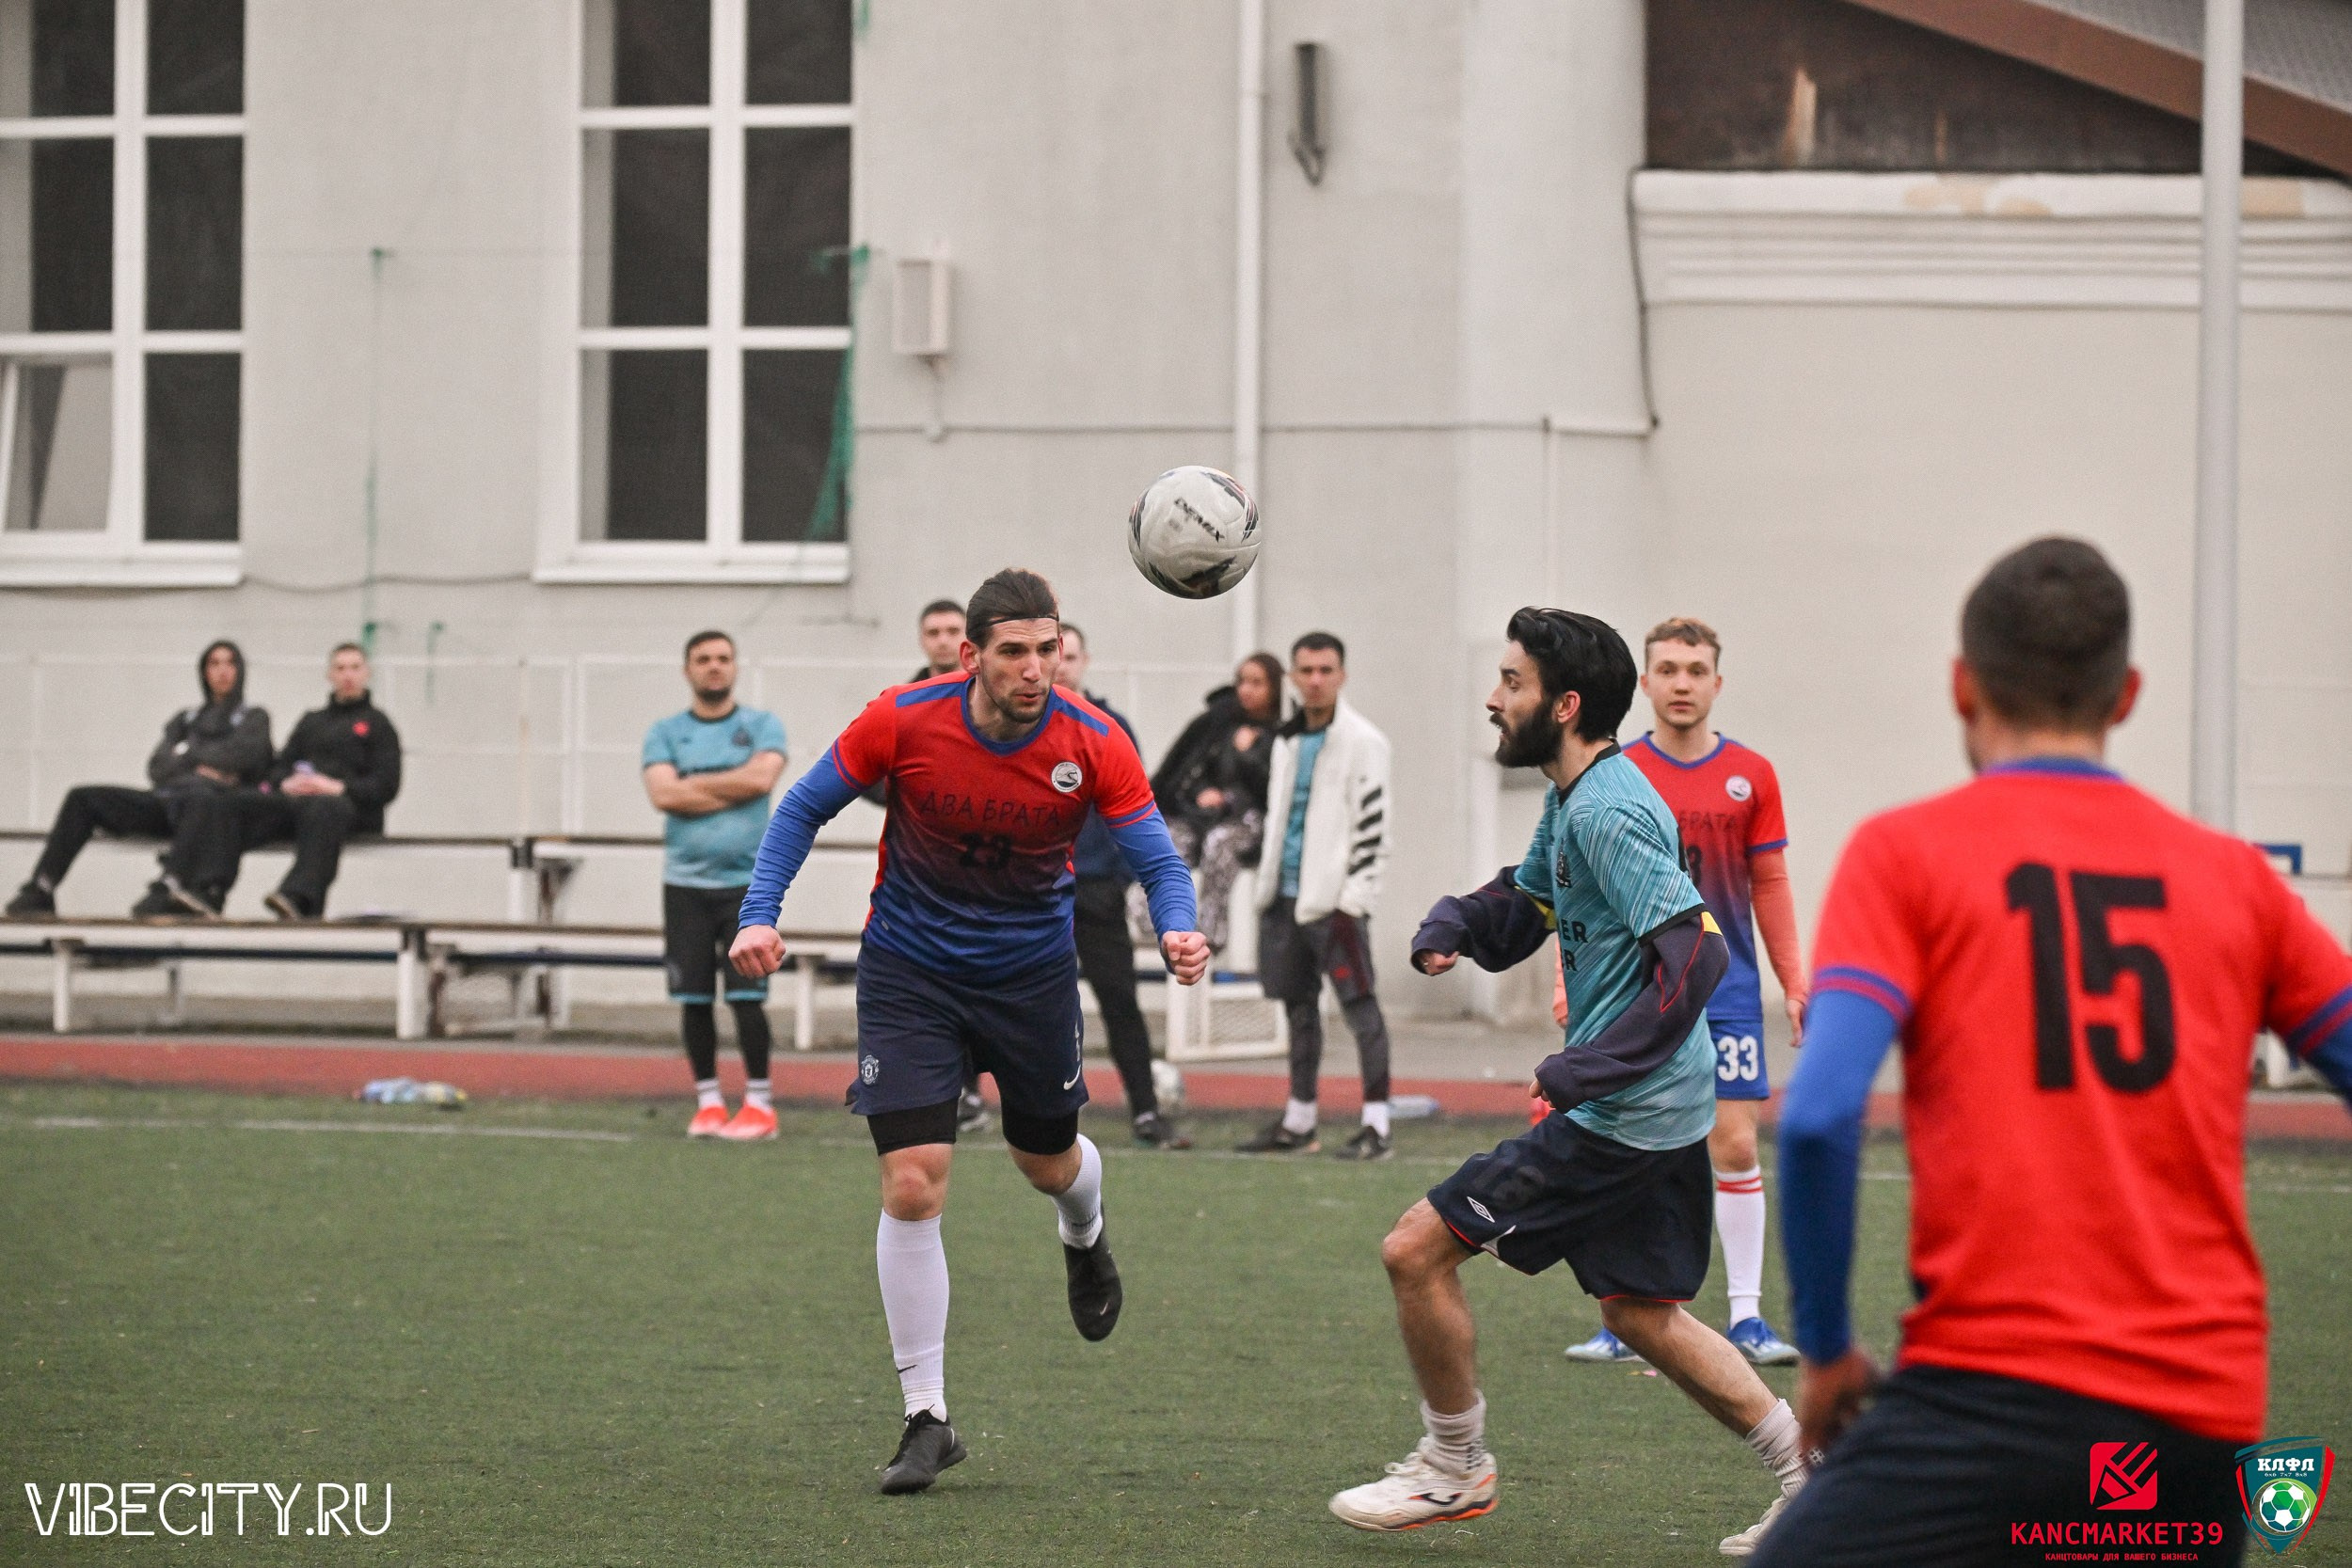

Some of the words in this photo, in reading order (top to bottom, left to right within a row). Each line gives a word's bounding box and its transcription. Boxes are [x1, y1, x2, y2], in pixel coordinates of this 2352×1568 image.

[1560, 918, 1588, 943] ER
[2006, 863, 2176, 1094] 15
[1717, 1035, 1758, 1082] 33
